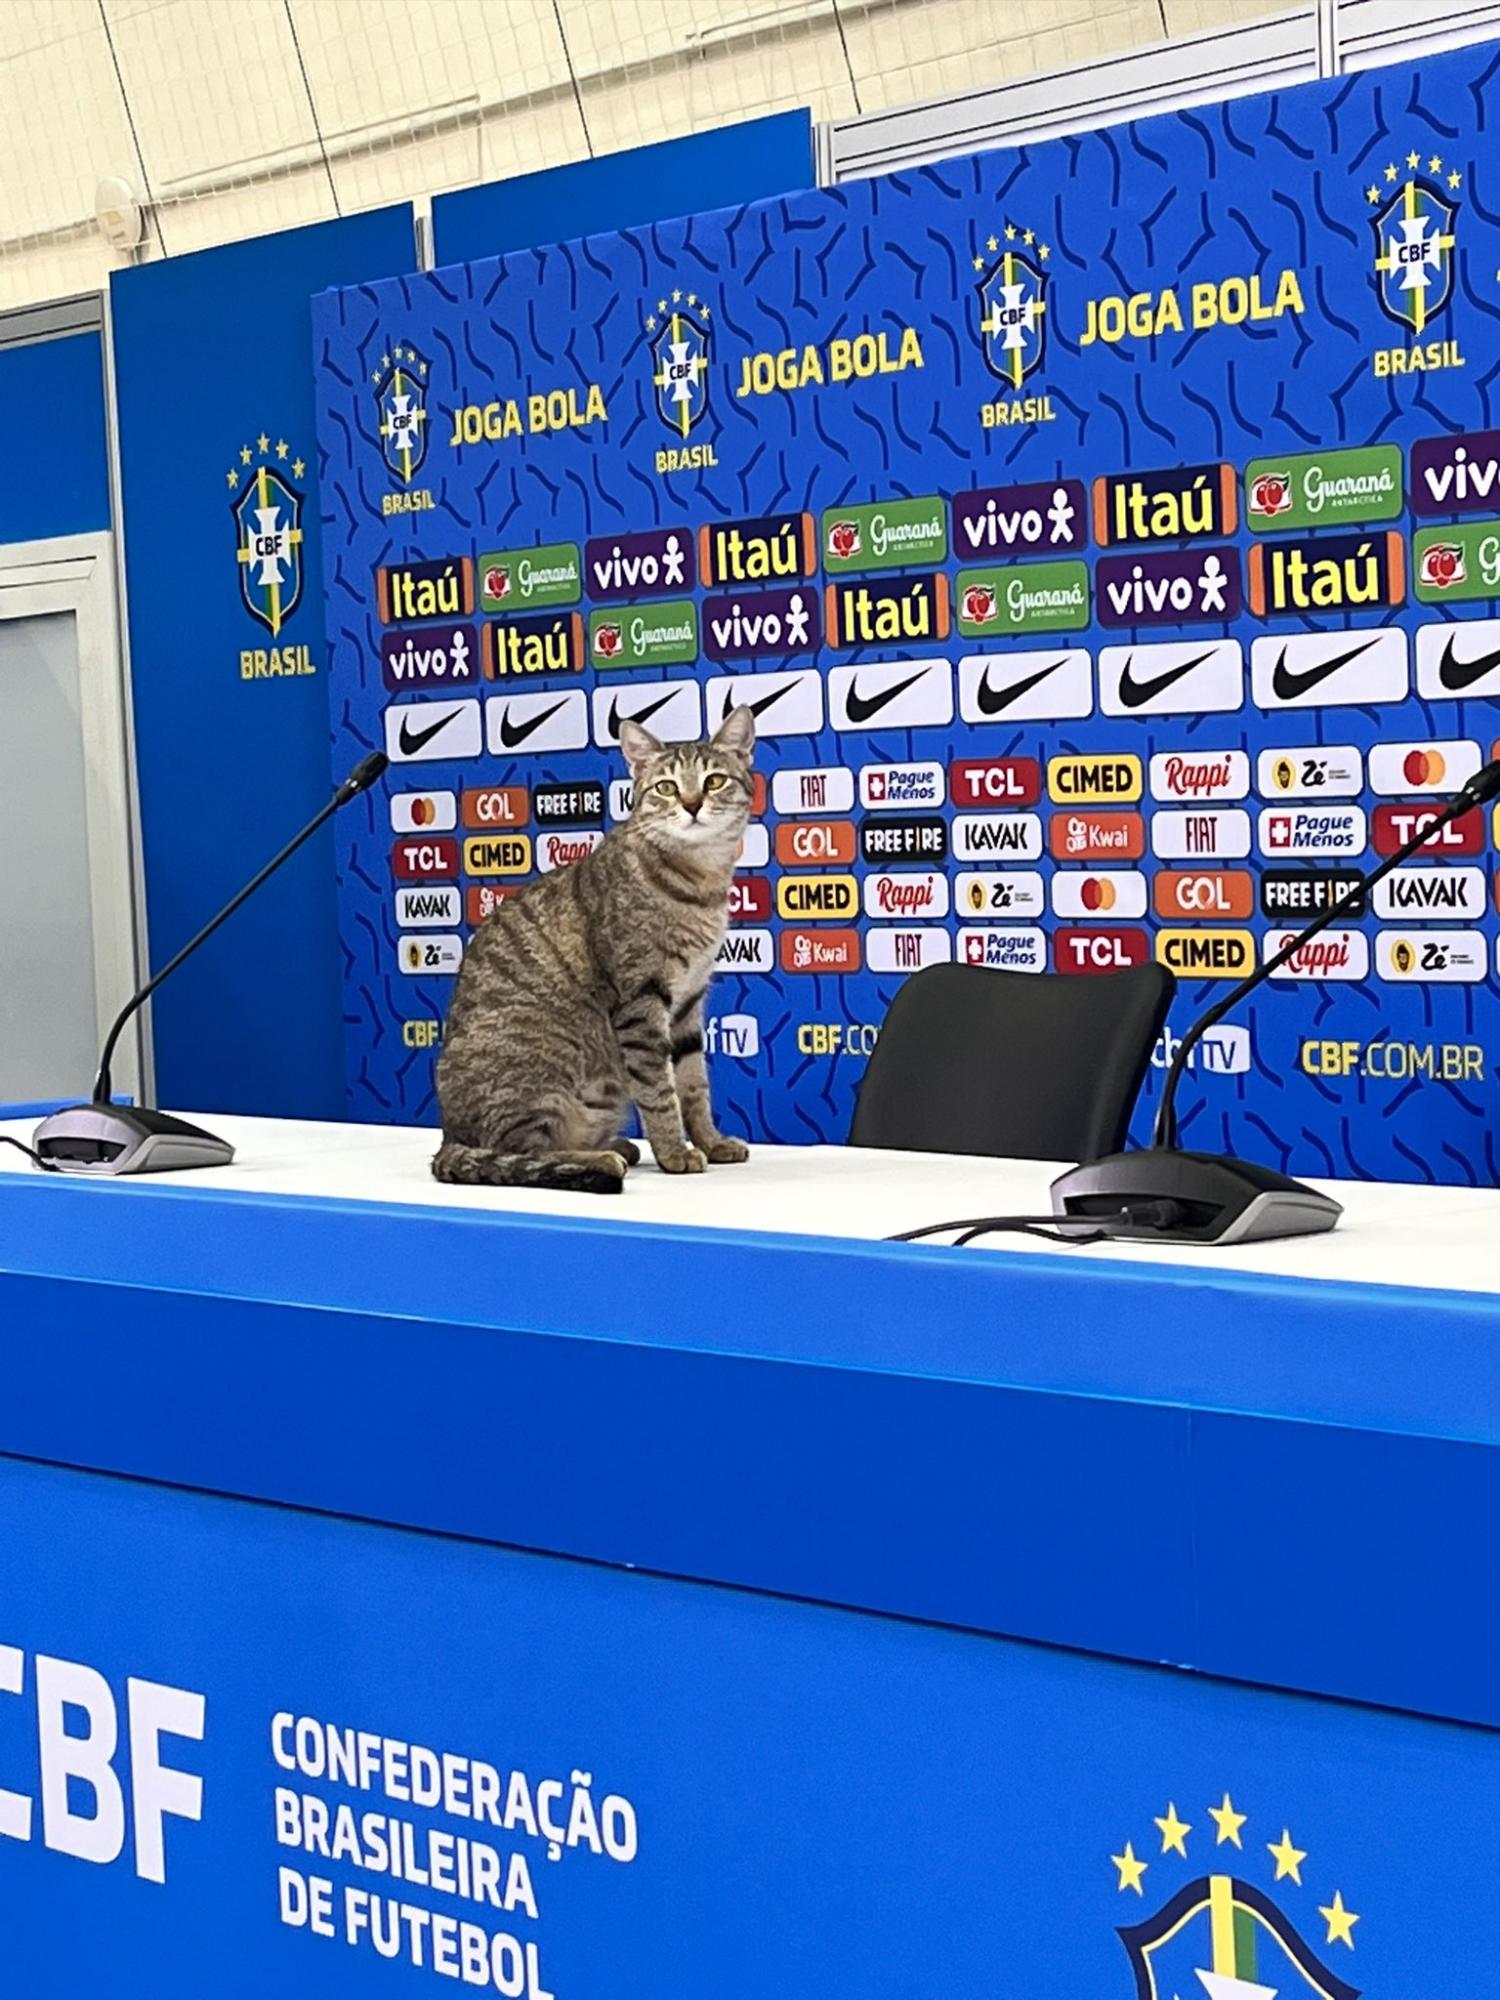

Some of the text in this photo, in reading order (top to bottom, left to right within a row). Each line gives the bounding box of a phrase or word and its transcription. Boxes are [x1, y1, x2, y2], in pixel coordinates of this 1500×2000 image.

[1397, 243, 1431, 265] CBF
[1000, 307, 1026, 326] CBF
[1080, 270, 1305, 345] JOGA BOLA
[669, 363, 692, 381] CBF
[736, 328, 924, 397] JOGA BOLA
[1374, 340, 1466, 378] BRASIL
[393, 413, 413, 430] CBF
[450, 385, 608, 447] JOGA BOLA
[981, 397, 1056, 428] BRASIL
[655, 445, 718, 474] BRASIL
[1424, 447, 1500, 502] viv
[382, 490, 435, 515] BRASIL
[1303, 466, 1395, 513] Guaraná
[1115, 475, 1214, 541] Itaú
[870, 514, 943, 556] Guaraná
[963, 499, 1043, 548] vivo
[255, 534, 283, 557] CBF
[716, 523, 798, 580] Itaú
[518, 559, 578, 598] Guaraná
[593, 546, 659, 590] vivo
[1272, 543, 1380, 608] Itaú
[392, 566, 459, 618] Itaú
[1007, 579, 1085, 622] Guaraná
[1107, 566, 1192, 615] vivo
[711, 604, 781, 648] vivo
[843, 583, 930, 642] Itaú
[497, 621, 568, 674] Itaú
[630, 617, 694, 656] Guaraná
[240, 645, 316, 680] BRASIL
[389, 639, 446, 679] vivo
[888, 770, 935, 788] Pague
[965, 768, 1024, 797] TCL
[1056, 764, 1133, 793] CIMED
[1165, 755, 1232, 797] Rappi
[1301, 760, 1328, 787] Zé
[536, 794, 568, 816] FREE
[569, 792, 601, 815] FIRE
[800, 774, 827, 808] FIAT
[887, 785, 936, 800] Menos
[476, 793, 515, 821] GOL
[864, 826, 943, 852] FREE FIRE
[964, 822, 1029, 851] KAVAK
[1089, 825, 1128, 848] Kwai
[1185, 816, 1218, 853] FIAT
[1294, 815, 1353, 833] Pague
[793, 827, 838, 859] GOL
[1293, 831, 1354, 848] Menos
[404, 846, 448, 872] TCL
[470, 842, 525, 869] CIMED
[404, 894, 452, 919] KAVAK
[727, 886, 758, 912] CL
[784, 883, 849, 911] CIMED
[877, 876, 934, 914] Rappi
[1176, 876, 1231, 911] GOL
[1265, 882, 1311, 908] FREE
[1389, 878, 1469, 908] KAVAK
[715, 937, 762, 962] AVAK
[813, 941, 848, 962] Kwai
[894, 934, 922, 966] FIAT
[986, 949, 1036, 965] Menos
[987, 934, 1034, 952] Pague
[1070, 937, 1131, 966] TCL
[1165, 938, 1245, 968] CIMED
[1421, 943, 1449, 971] Zé
[722, 1028, 748, 1054] TV
[1302, 1041, 1484, 1080] CBF.COM.BR
[271, 1711, 639, 1863] CONFEDERAÇÃO
[275, 1786, 540, 1919] BRASILEIRA
[278, 1866, 556, 2000] DE FUTEBOL
